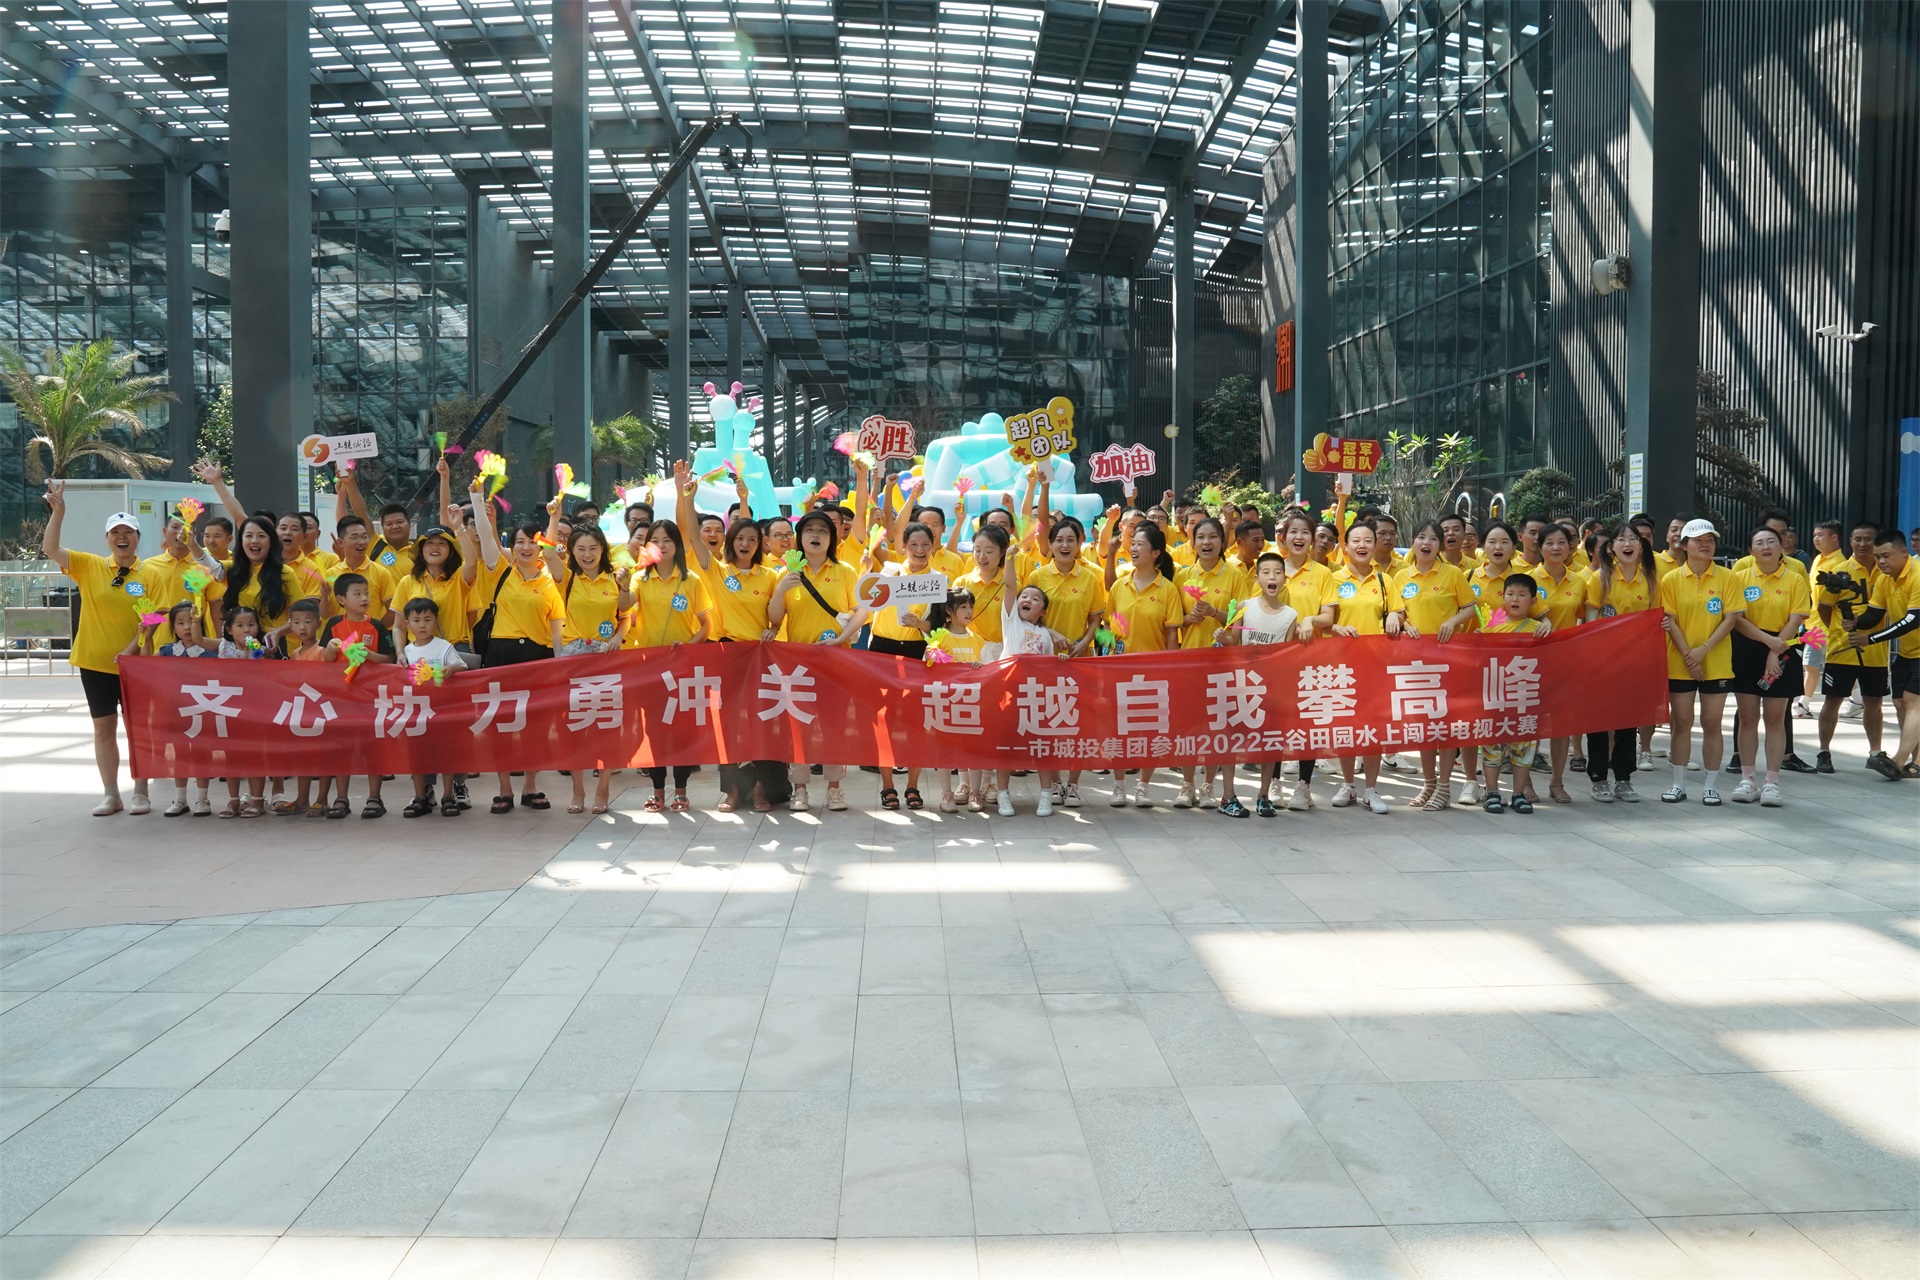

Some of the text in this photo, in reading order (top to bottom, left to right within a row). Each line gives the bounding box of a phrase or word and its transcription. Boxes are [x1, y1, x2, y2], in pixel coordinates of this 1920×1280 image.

[1010, 413, 1053, 441] 超凡
[863, 423, 910, 456] 必胜
[1030, 430, 1072, 457] 团队
[1343, 442, 1373, 456] 冠军
[1095, 448, 1150, 479] 加油
[1343, 456, 1373, 470] 团队
[127, 584, 142, 593] 365
[726, 578, 739, 590] 361
[1340, 585, 1354, 595] 291
[1404, 586, 1417, 596] 292
[1745, 589, 1759, 598] 323
[673, 597, 687, 608] 347
[1603, 607, 1615, 616] 319
[600, 624, 613, 634] 276
[178, 655, 1542, 739] 齐心协力勇冲关 超越自我攀高峰
